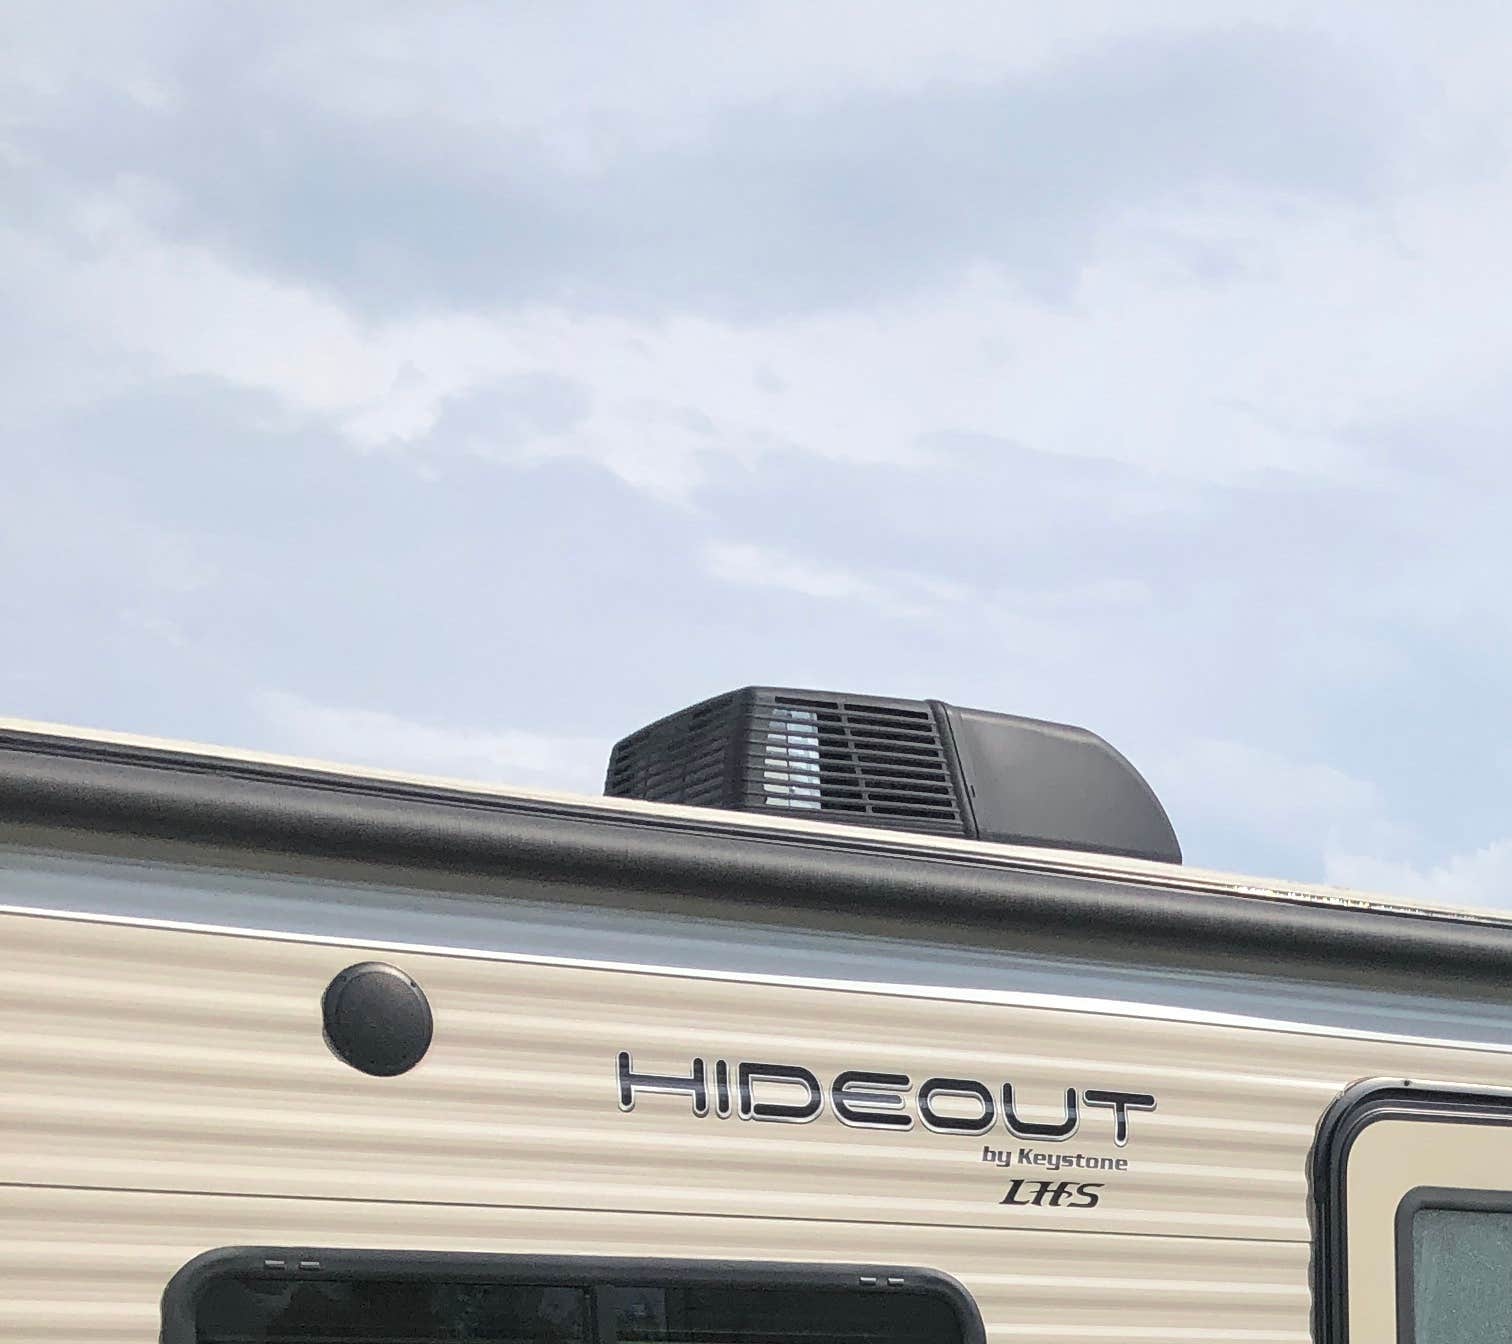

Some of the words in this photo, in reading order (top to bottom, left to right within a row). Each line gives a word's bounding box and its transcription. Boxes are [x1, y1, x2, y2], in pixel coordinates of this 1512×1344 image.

[615, 1050, 1157, 1147] HIDEOUT
[982, 1146, 1012, 1168] by
[1017, 1148, 1128, 1171] Keystone
